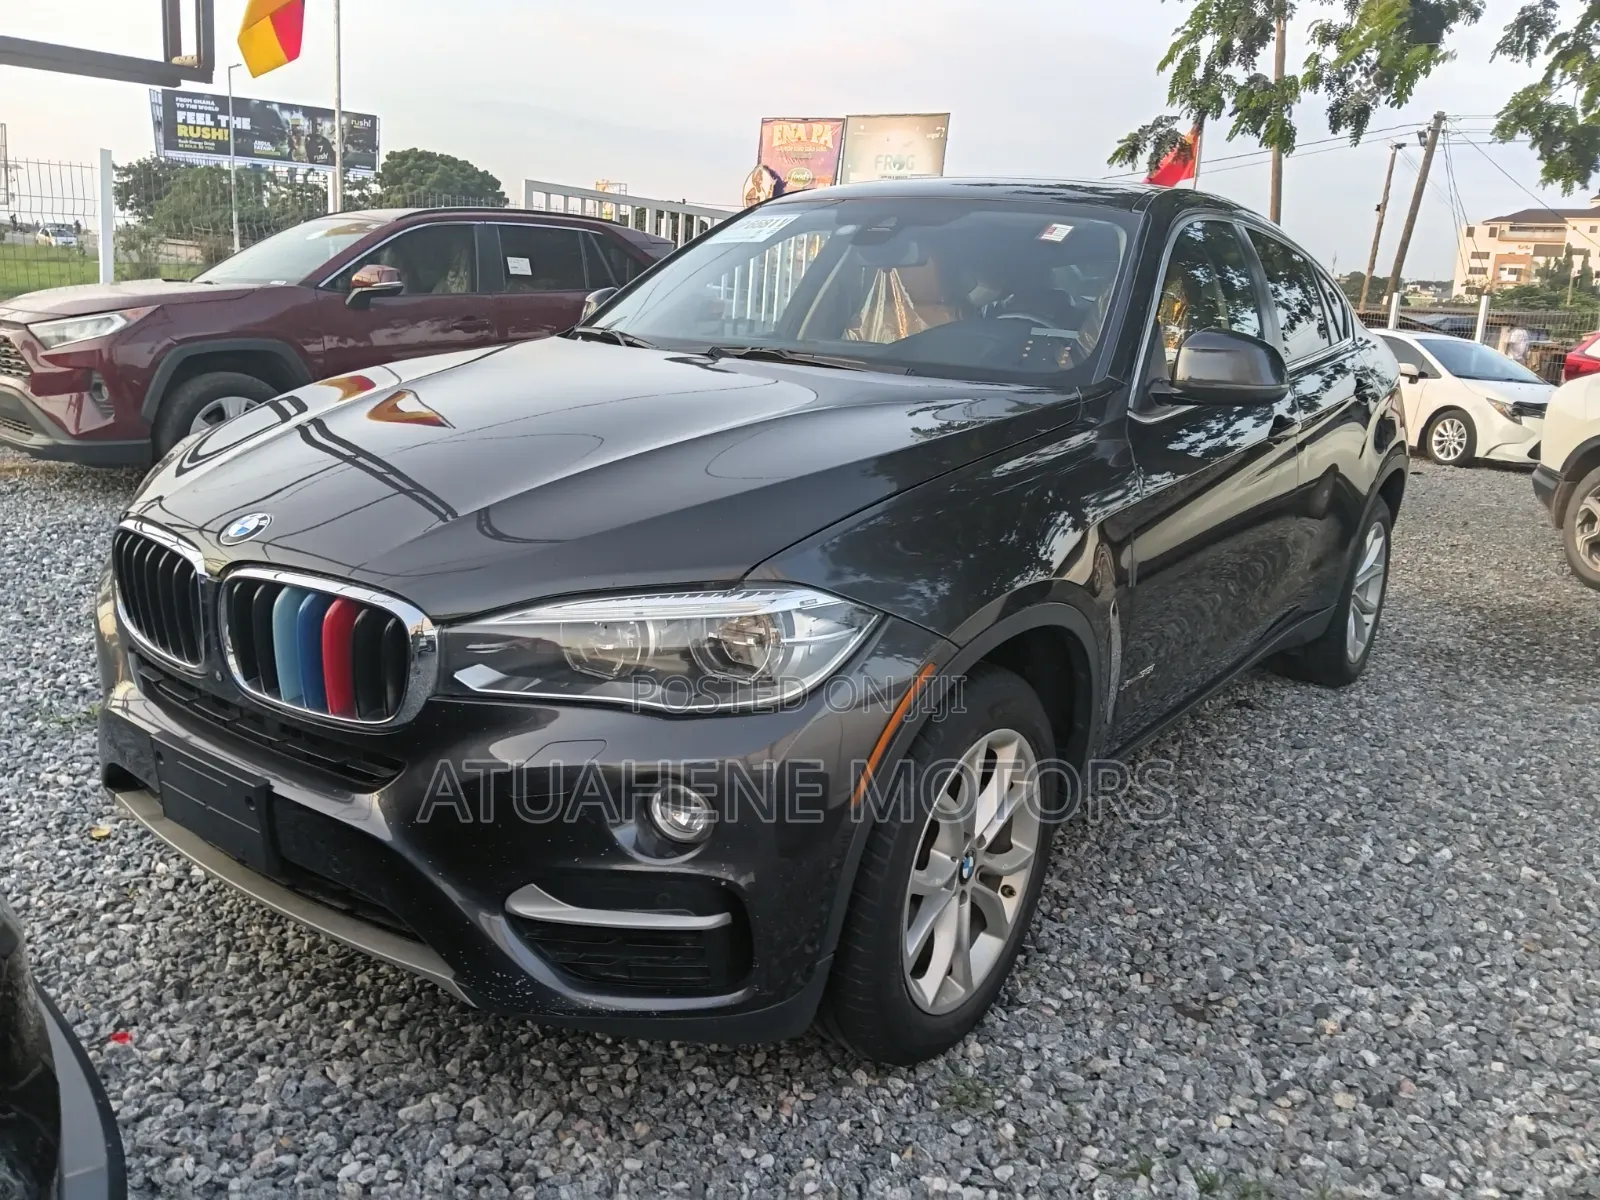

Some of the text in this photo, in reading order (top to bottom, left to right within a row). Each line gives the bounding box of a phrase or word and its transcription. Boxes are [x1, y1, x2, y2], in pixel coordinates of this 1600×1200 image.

[177, 111, 251, 130] FEEL THE
[177, 124, 229, 141] RUSH!
[772, 123, 834, 149] ENA PA
